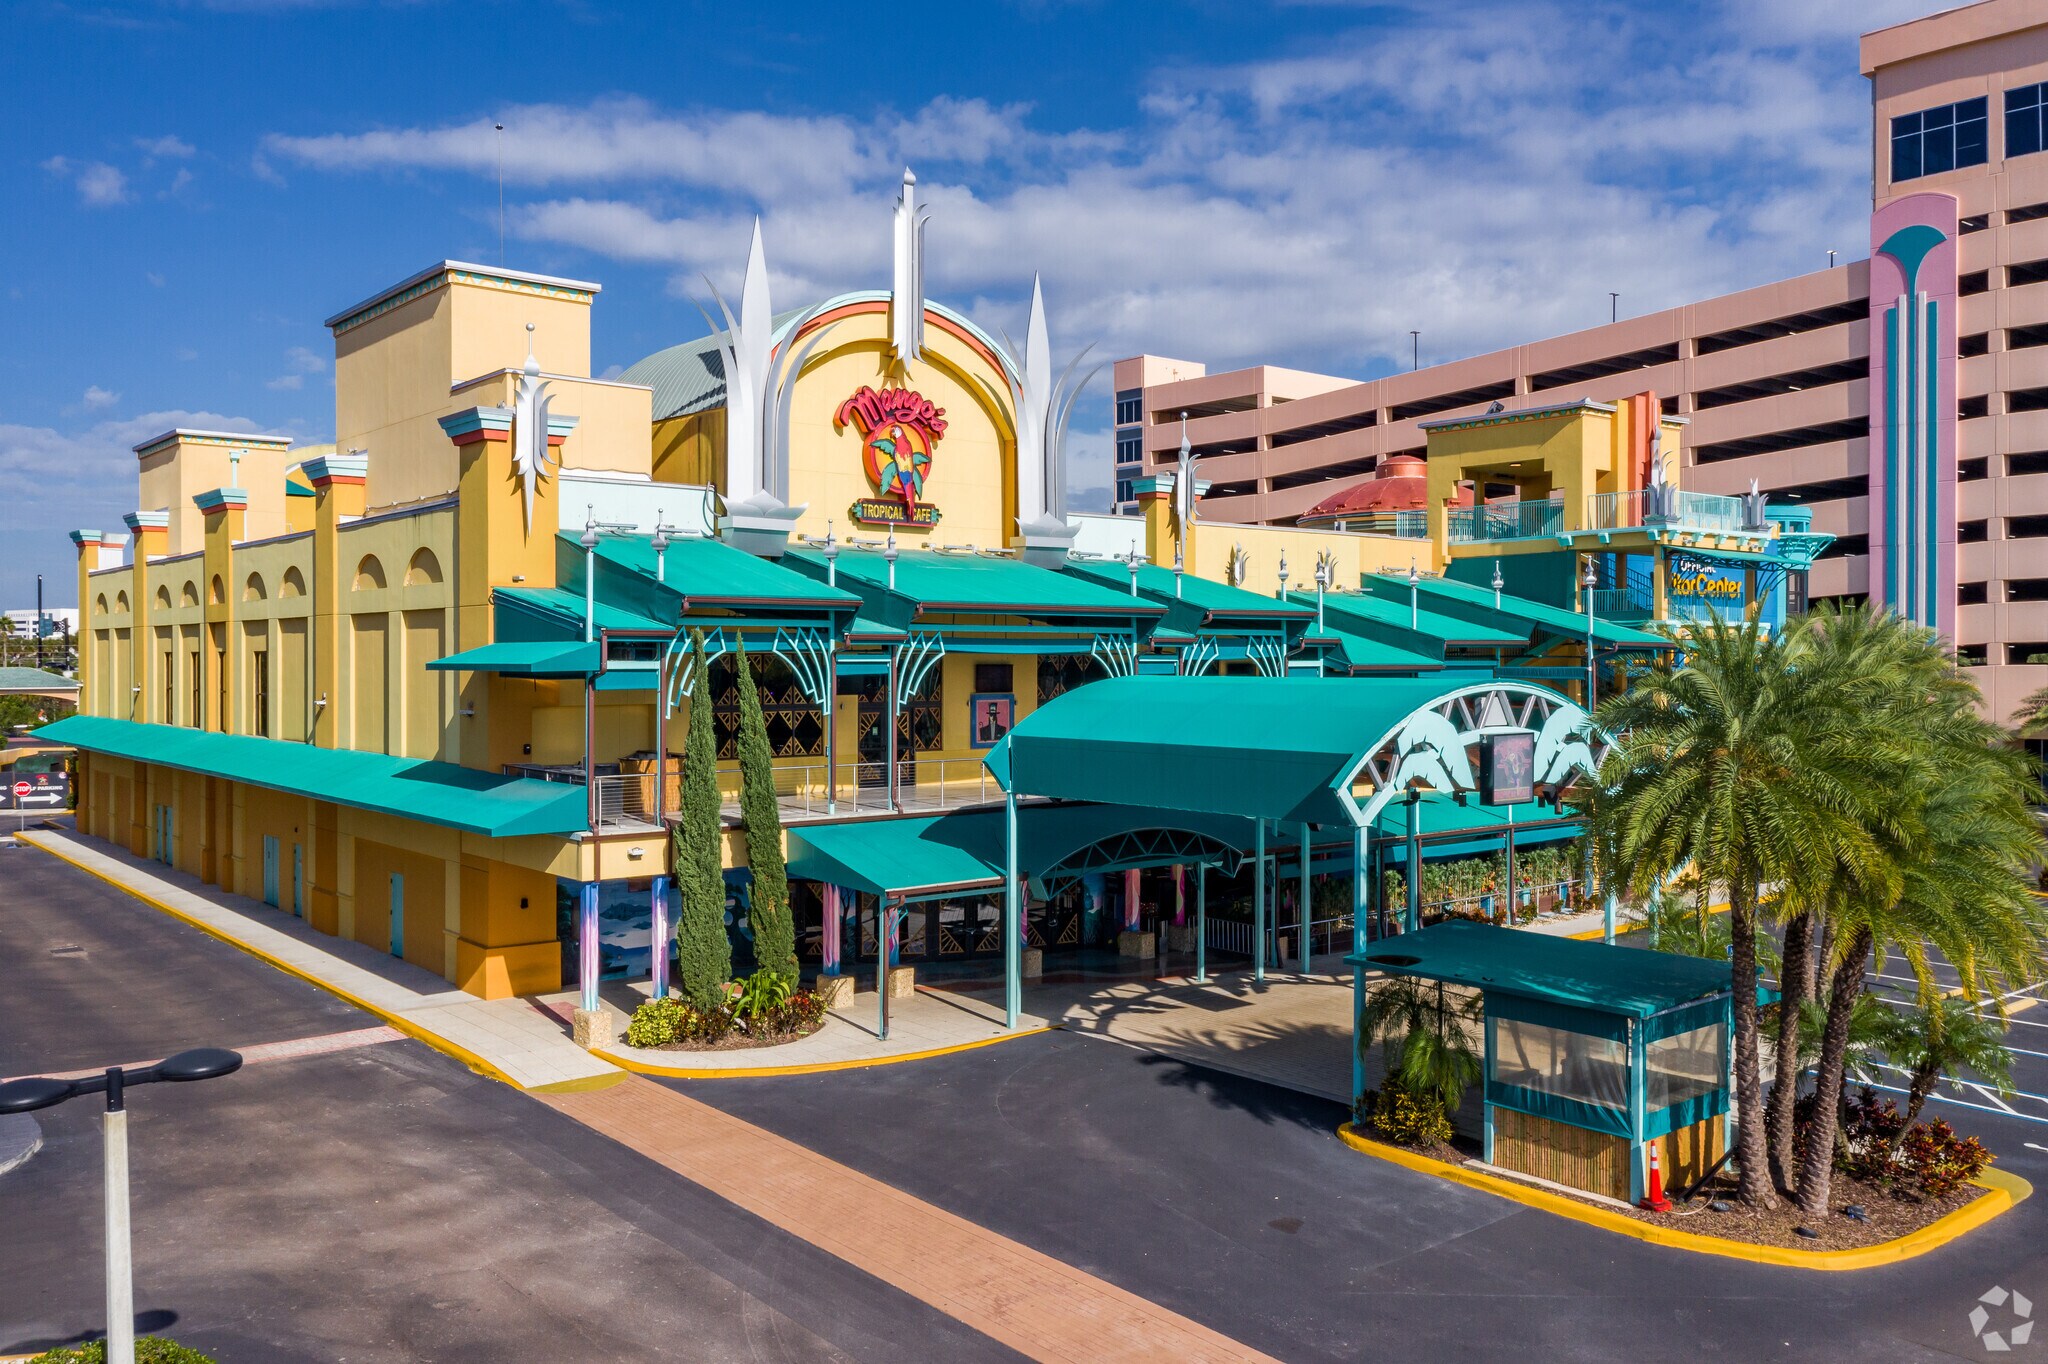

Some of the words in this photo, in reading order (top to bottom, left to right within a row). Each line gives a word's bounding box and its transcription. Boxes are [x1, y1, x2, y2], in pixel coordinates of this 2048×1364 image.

[837, 384, 949, 441] Mango's
[862, 503, 904, 520] TROPICAL
[913, 508, 932, 522] CAFE
[1696, 573, 1742, 599] Center
